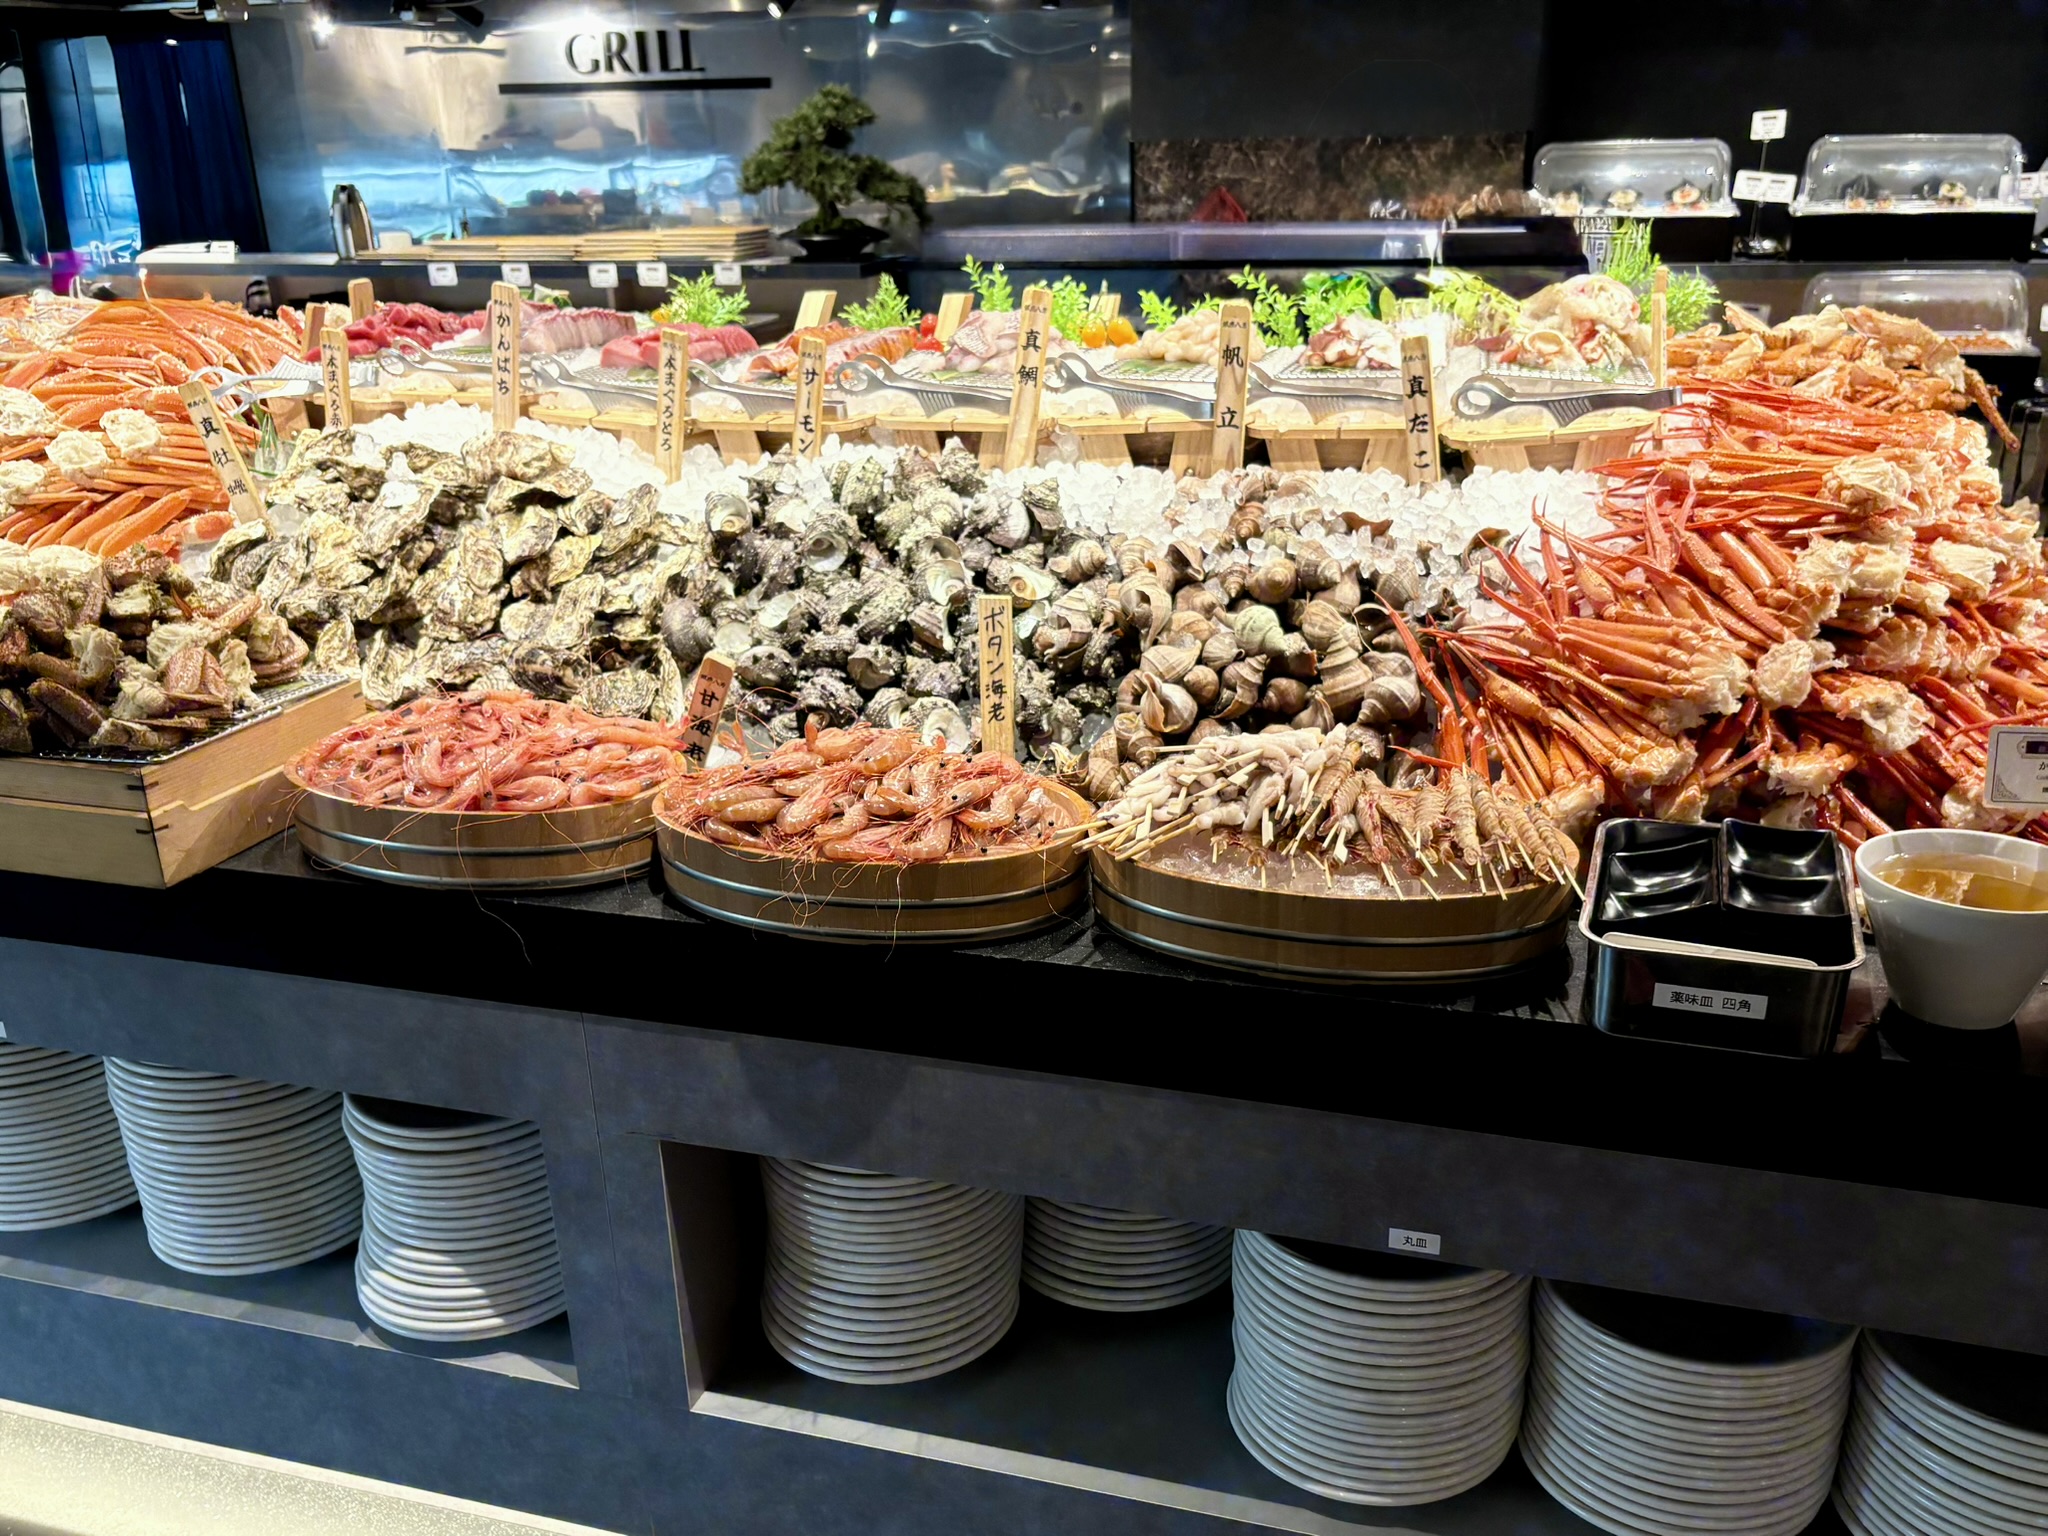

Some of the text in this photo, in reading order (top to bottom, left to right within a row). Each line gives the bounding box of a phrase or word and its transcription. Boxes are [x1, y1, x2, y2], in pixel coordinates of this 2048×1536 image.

[564, 29, 705, 75] GRILL
[1016, 328, 1041, 389] 真鯛
[1216, 344, 1244, 429] 帆立
[660, 354, 678, 452] 本まぐろとろ
[798, 367, 819, 454] サーモン
[1405, 375, 1430, 469] 真だこ
[983, 605, 1007, 724] ボタン海老
[683, 688, 720, 762] 甘海老
[1669, 991, 1752, 1013] 薬味皿 四角
[1402, 1235, 1427, 1248] 丸皿
